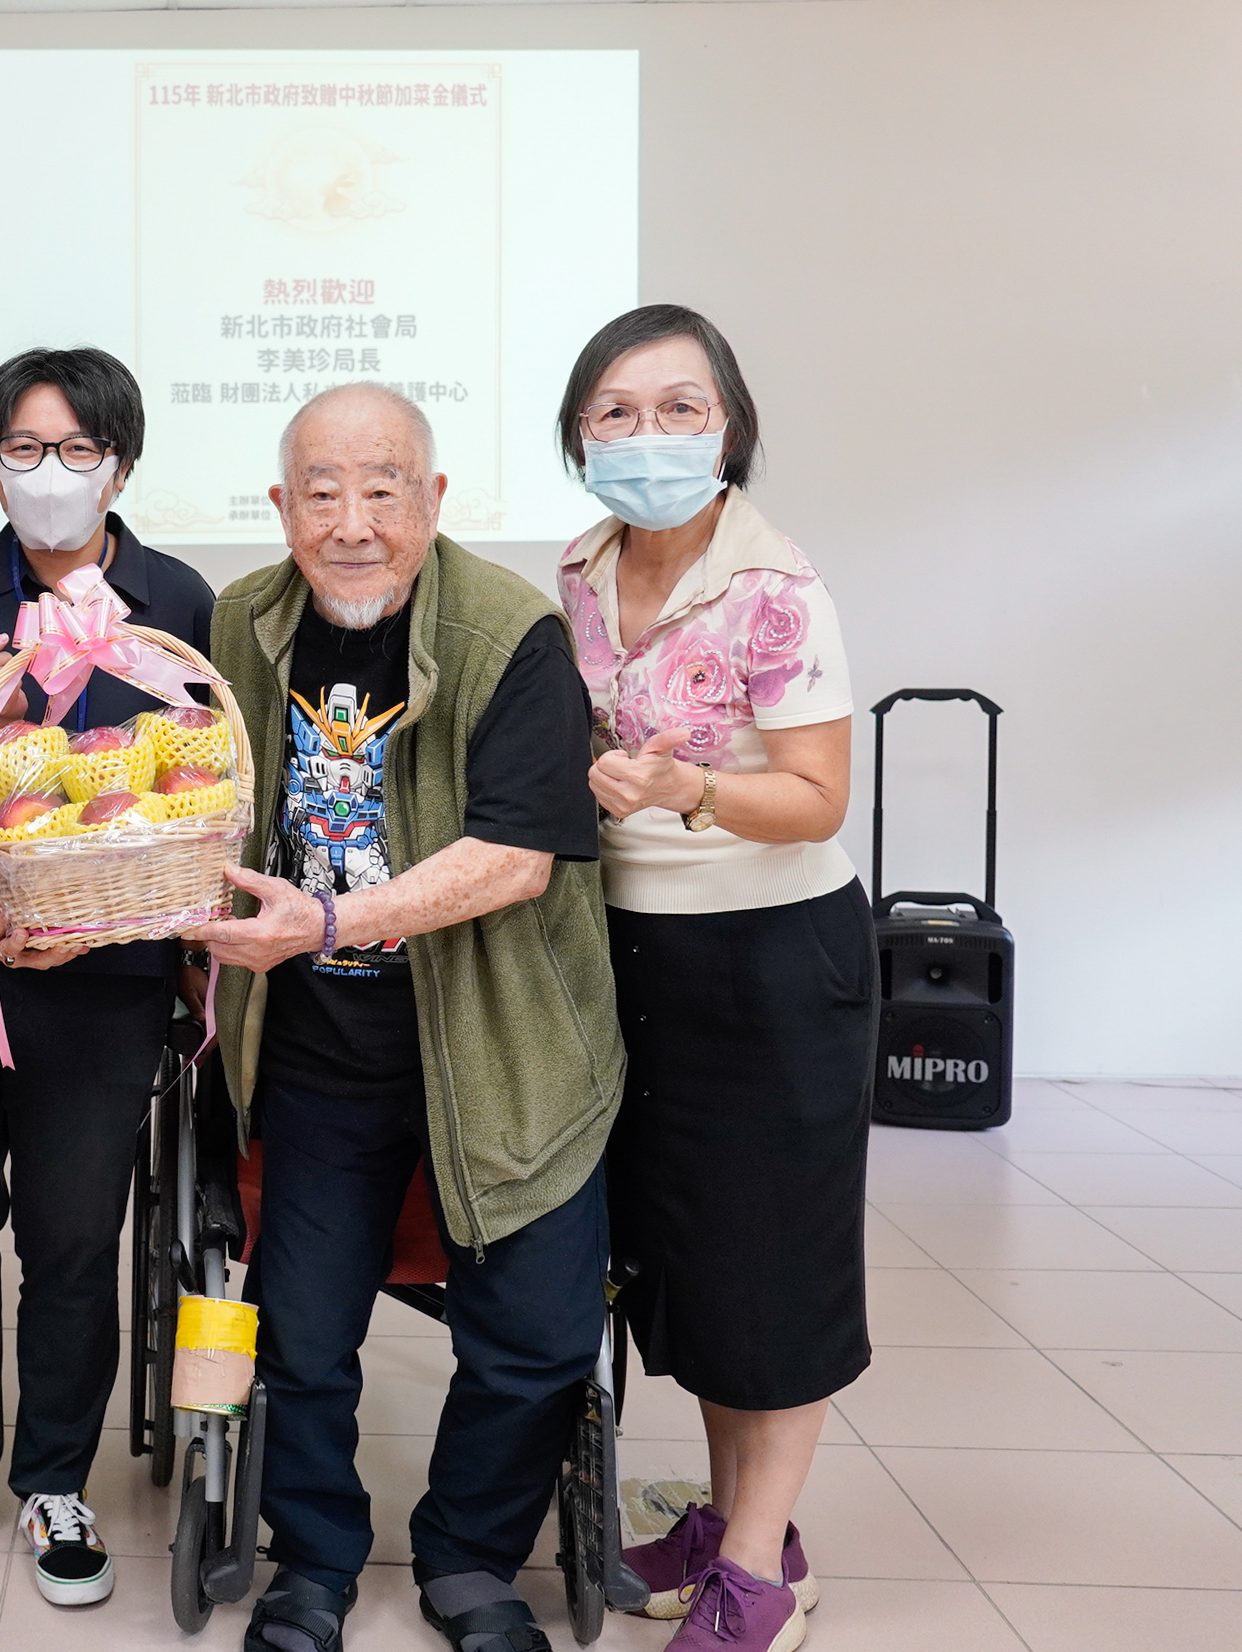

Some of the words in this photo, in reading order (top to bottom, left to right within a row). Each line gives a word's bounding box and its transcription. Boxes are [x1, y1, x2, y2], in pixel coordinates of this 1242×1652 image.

[149, 83, 201, 107] 115年
[207, 83, 488, 107] 新北市政府致贈中秋節加菜金儀式
[263, 278, 375, 305] 熱烈歡迎
[220, 314, 417, 339] 新北市政府社會局
[257, 348, 381, 372] 李美珍局長
[170, 382, 212, 404] 蒞臨
[311, 965, 381, 977] POPULARITY
[887, 1045, 989, 1084] MIPRO
